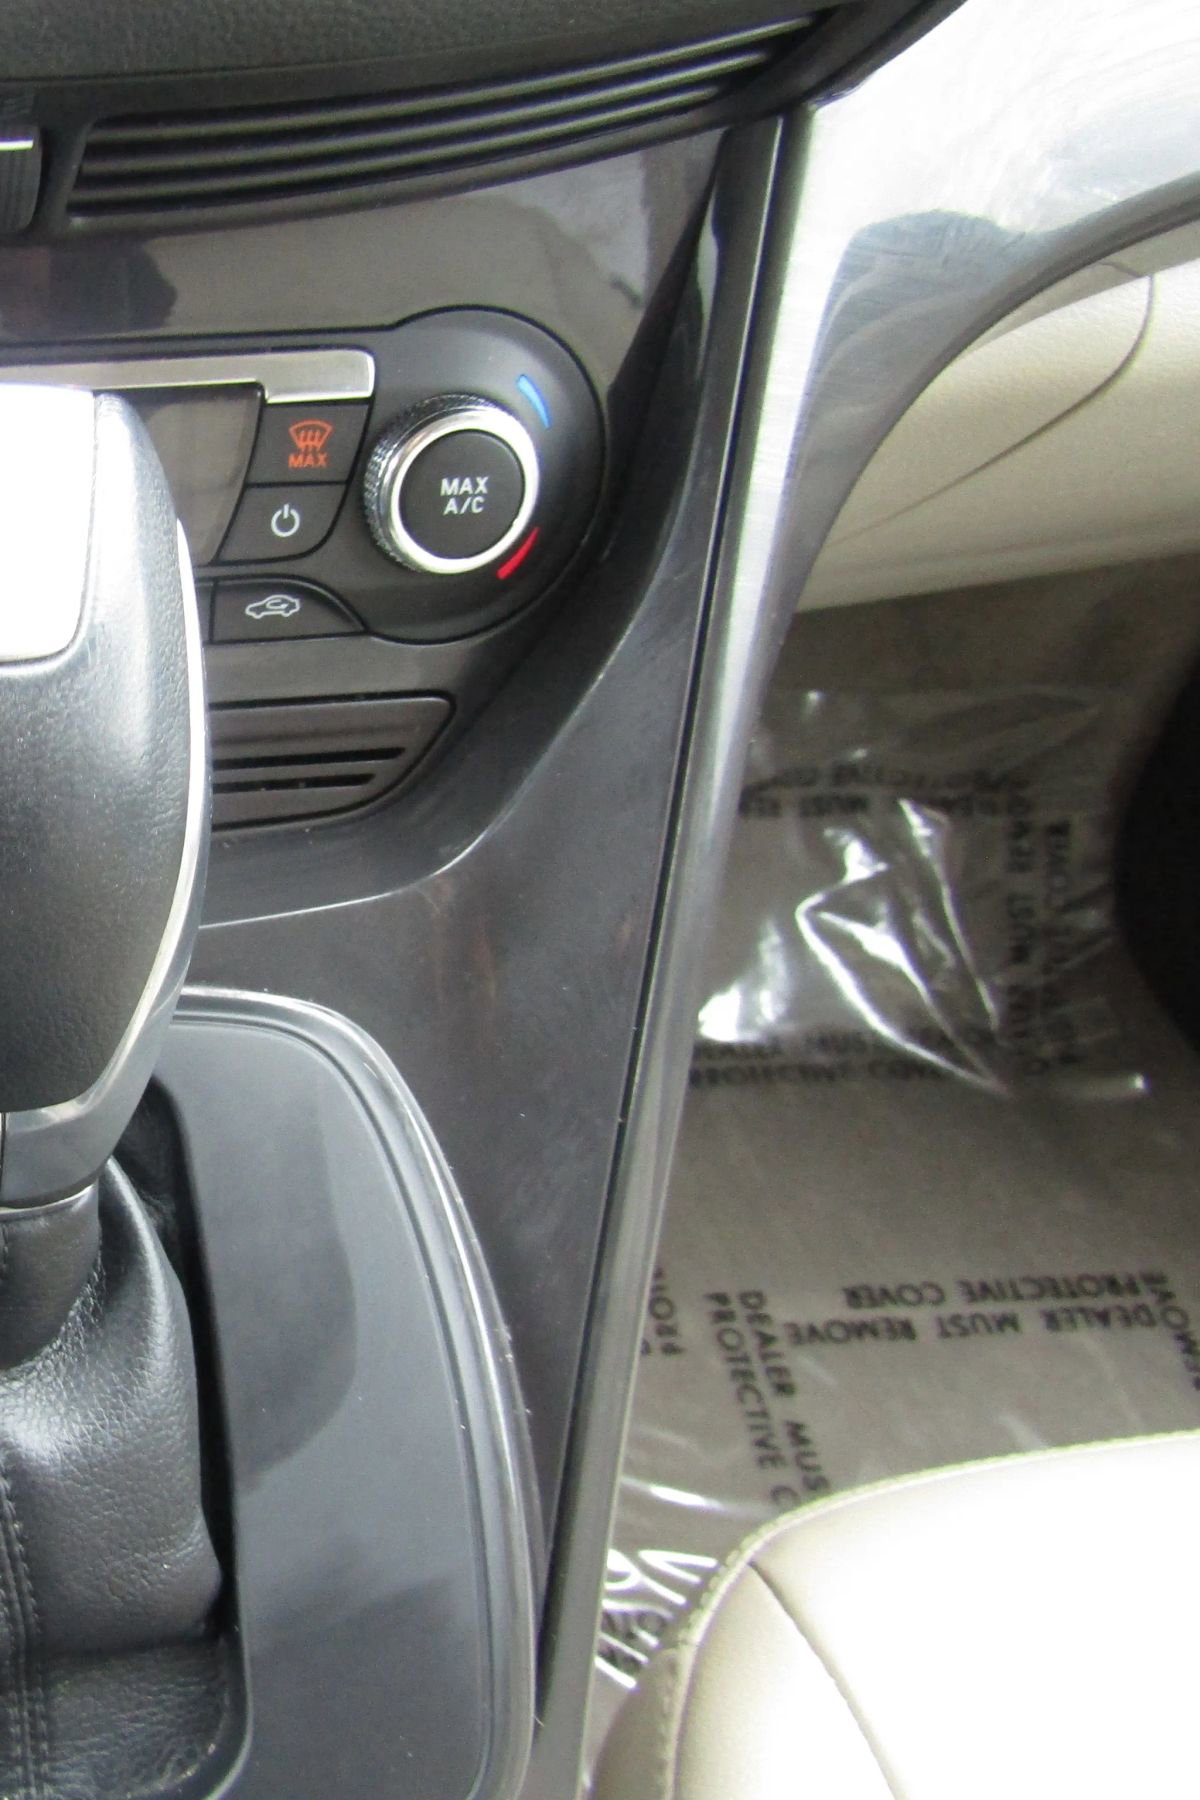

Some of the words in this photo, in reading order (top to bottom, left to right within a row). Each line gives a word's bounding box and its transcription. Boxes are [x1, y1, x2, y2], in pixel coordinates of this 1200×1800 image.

[287, 453, 329, 469] MAX
[440, 476, 489, 496] MAX
[443, 497, 485, 516] A/C
[842, 1281, 946, 1309] COVER
[957, 1271, 1141, 1306] PROTECTIVE
[784, 1316, 917, 1346] REMOVE
[935, 1310, 1021, 1339] MUST
[1041, 1303, 1157, 1333] DEALER
[702, 1291, 788, 1469] PROTECTIVE
[737, 1290, 798, 1398] DEALER
[784, 1419, 831, 1493] MUS
